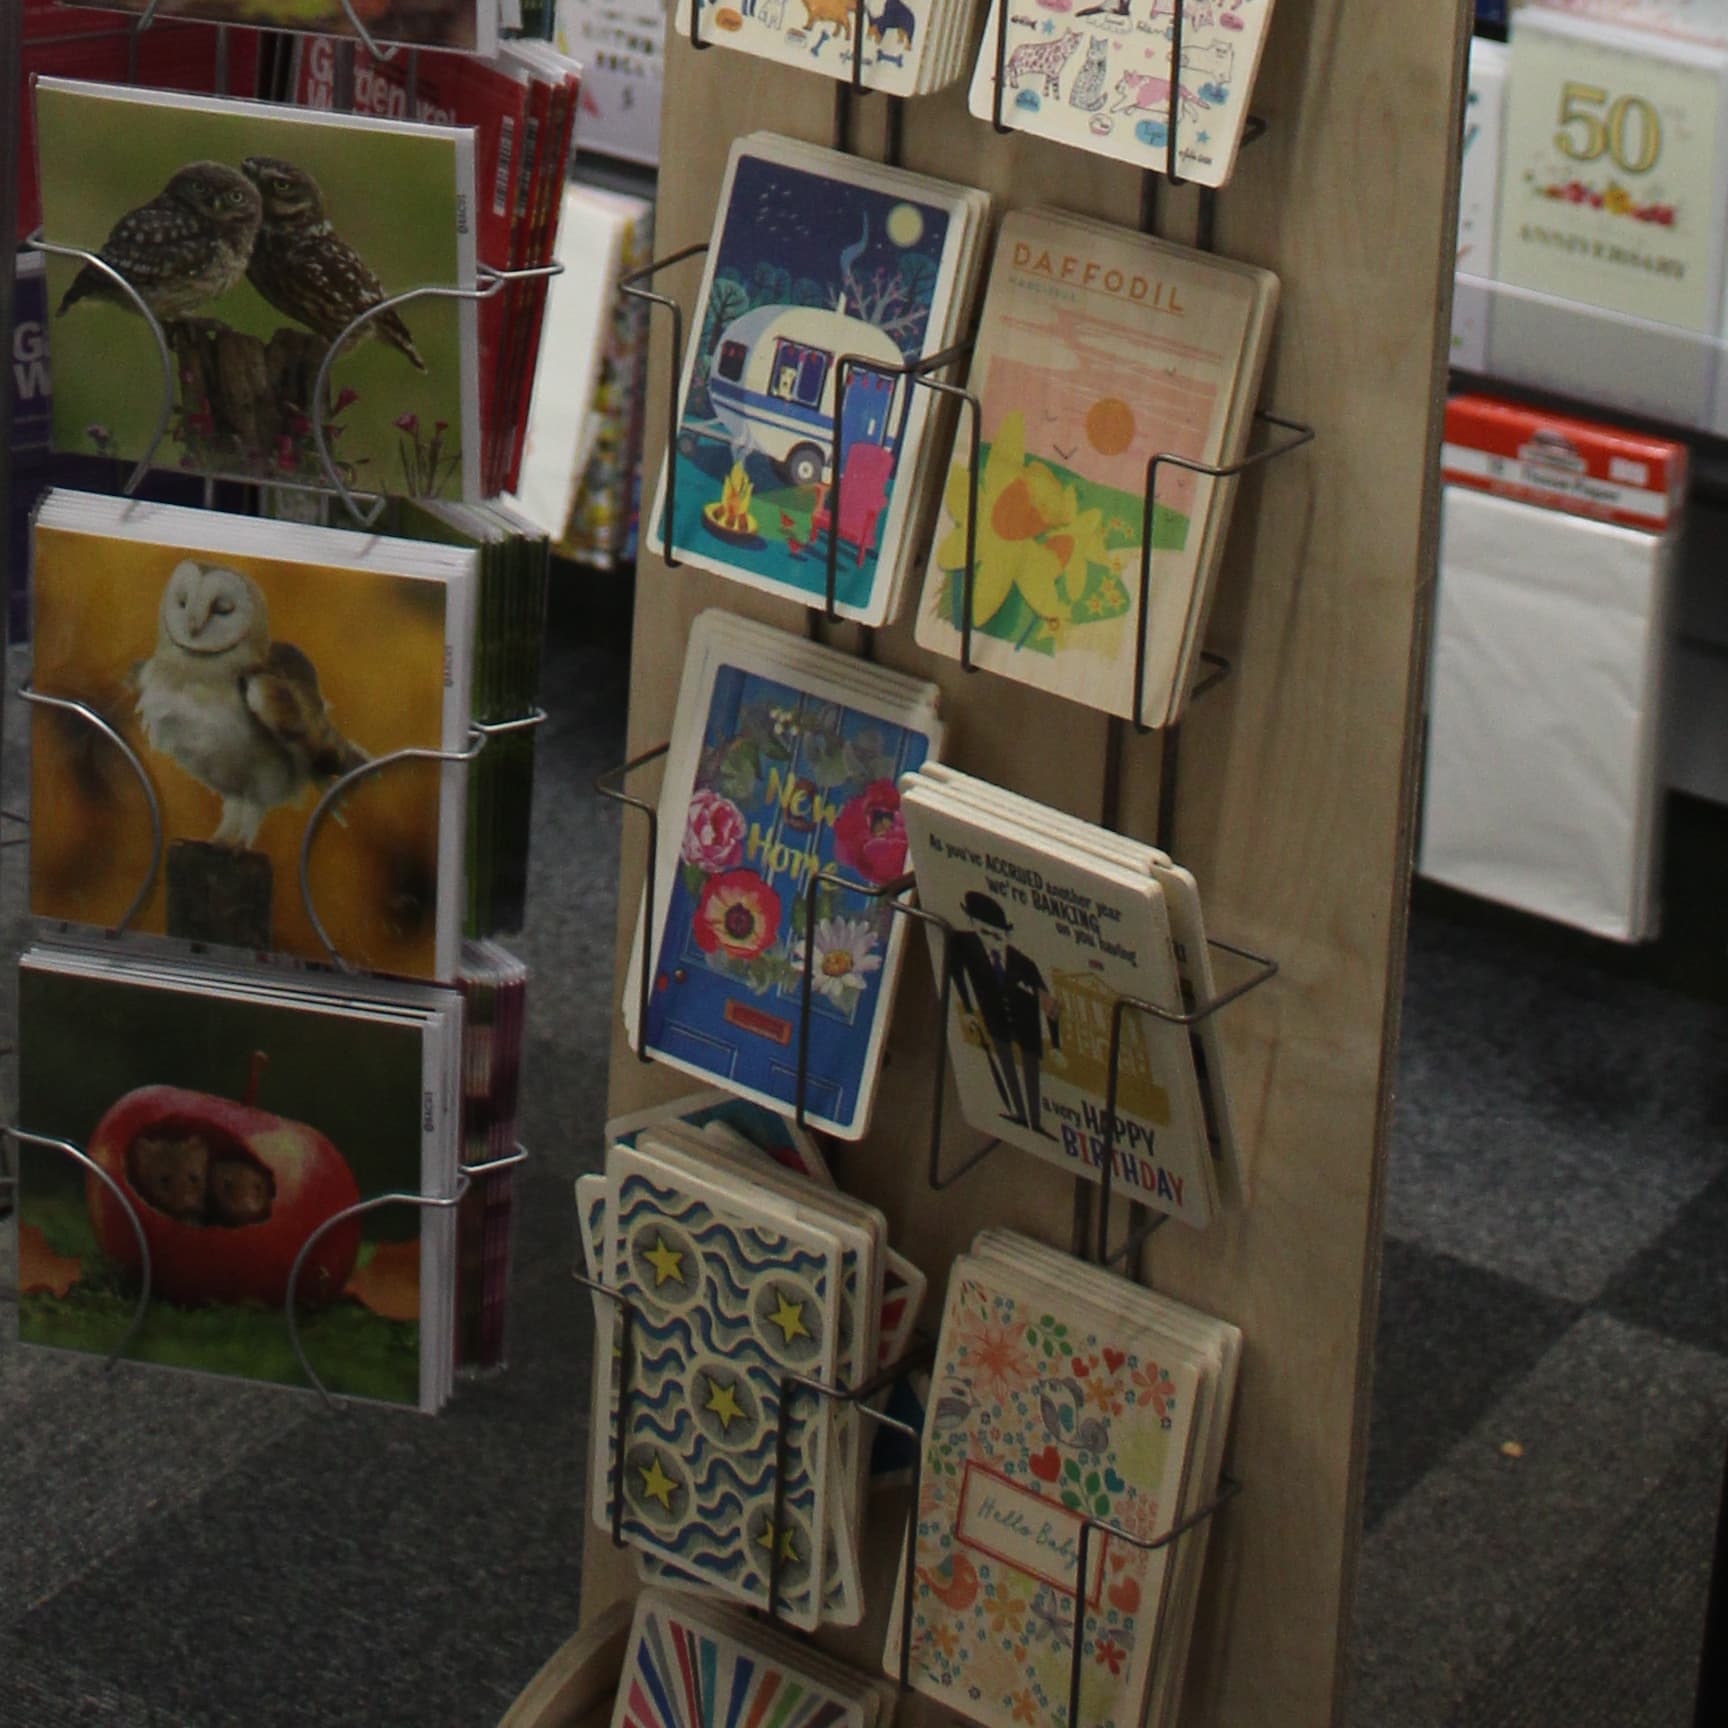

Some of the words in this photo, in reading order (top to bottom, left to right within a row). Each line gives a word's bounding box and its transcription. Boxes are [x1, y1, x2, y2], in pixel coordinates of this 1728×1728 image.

[1556, 80, 1662, 175] 50
[1012, 241, 1185, 313] DAFFODIL
[765, 767, 837, 828] New
[747, 823, 840, 892] Home
[985, 853, 1044, 890] ACCRUED
[1032, 889, 1102, 935] BANKING
[1060, 1122, 1184, 1208] BIRTHDAY
[978, 1495, 1031, 1537] Hello
